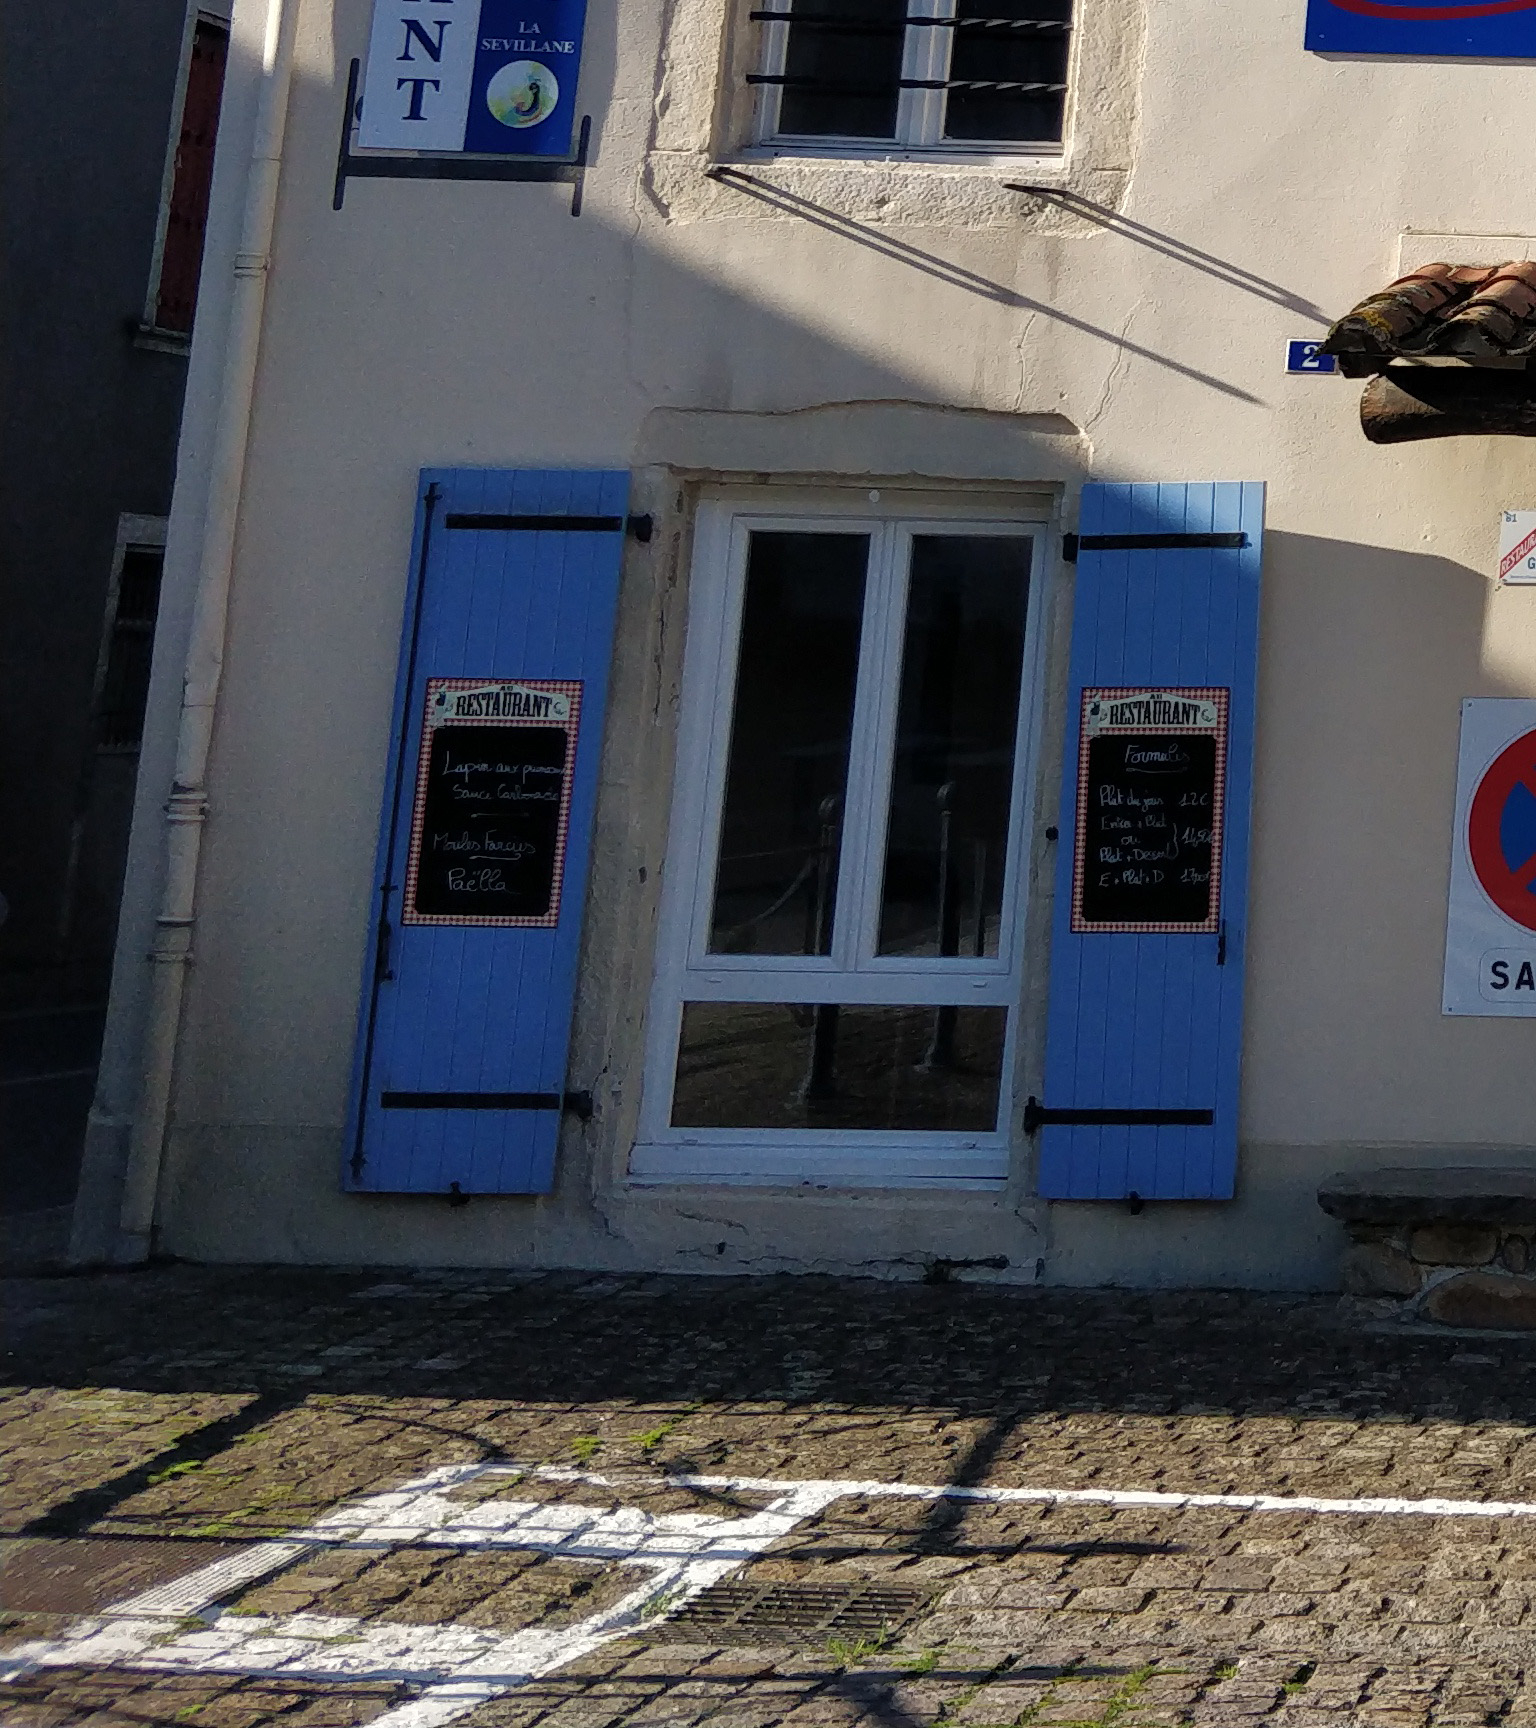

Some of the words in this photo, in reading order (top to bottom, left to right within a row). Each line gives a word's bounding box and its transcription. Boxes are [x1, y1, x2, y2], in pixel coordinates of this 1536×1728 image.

[518, 21, 541, 35] LA
[481, 37, 575, 55] SEVILLANE
[1302, 345, 1319, 368] 2
[455, 691, 553, 718] RESTAURANT
[1109, 700, 1201, 725] RESTAURANT
[453, 784, 491, 800] Sauce
[448, 867, 508, 892] Paëlla
